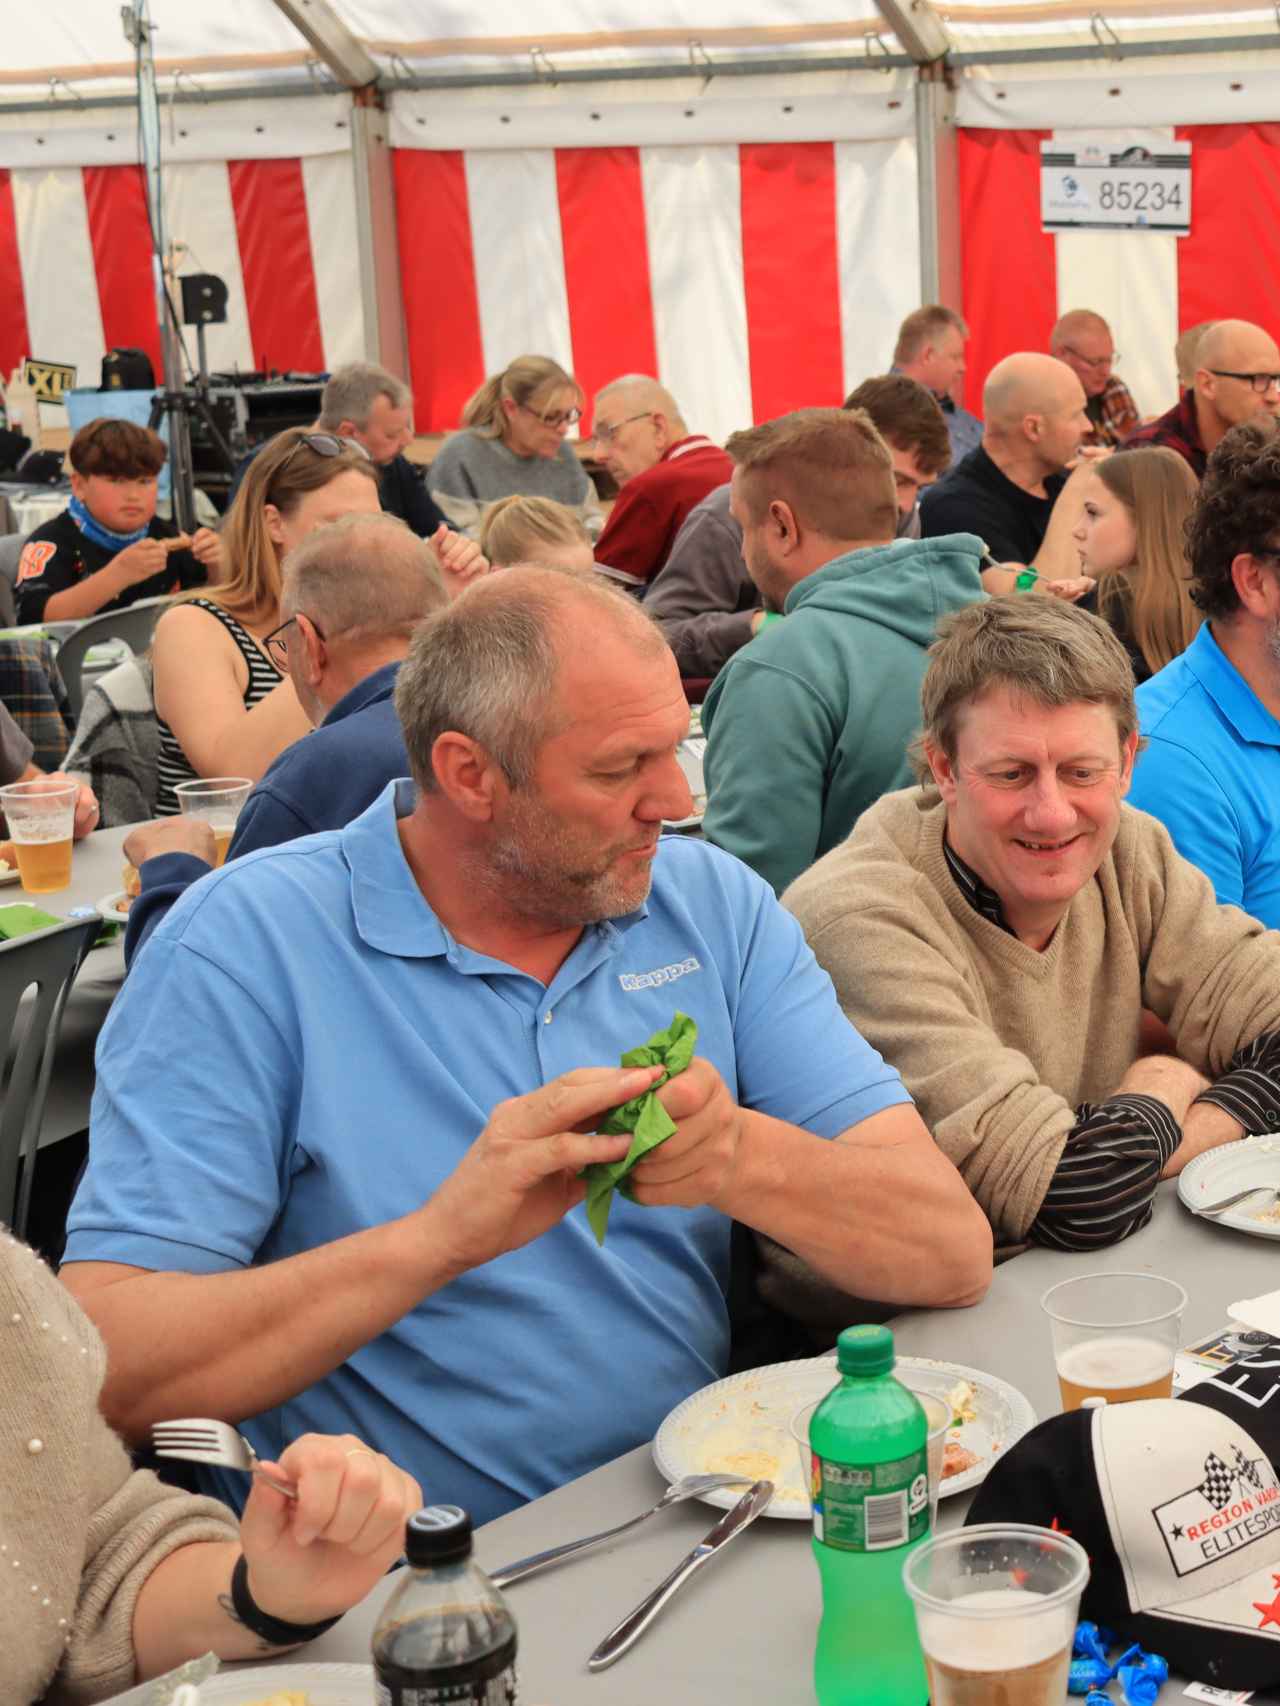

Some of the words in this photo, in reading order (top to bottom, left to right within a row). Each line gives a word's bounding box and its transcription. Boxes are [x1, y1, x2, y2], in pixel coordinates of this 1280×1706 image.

[1100, 181, 1183, 210] 85234
[618, 958, 700, 992] Kappa
[1187, 1498, 1253, 1541] REGION
